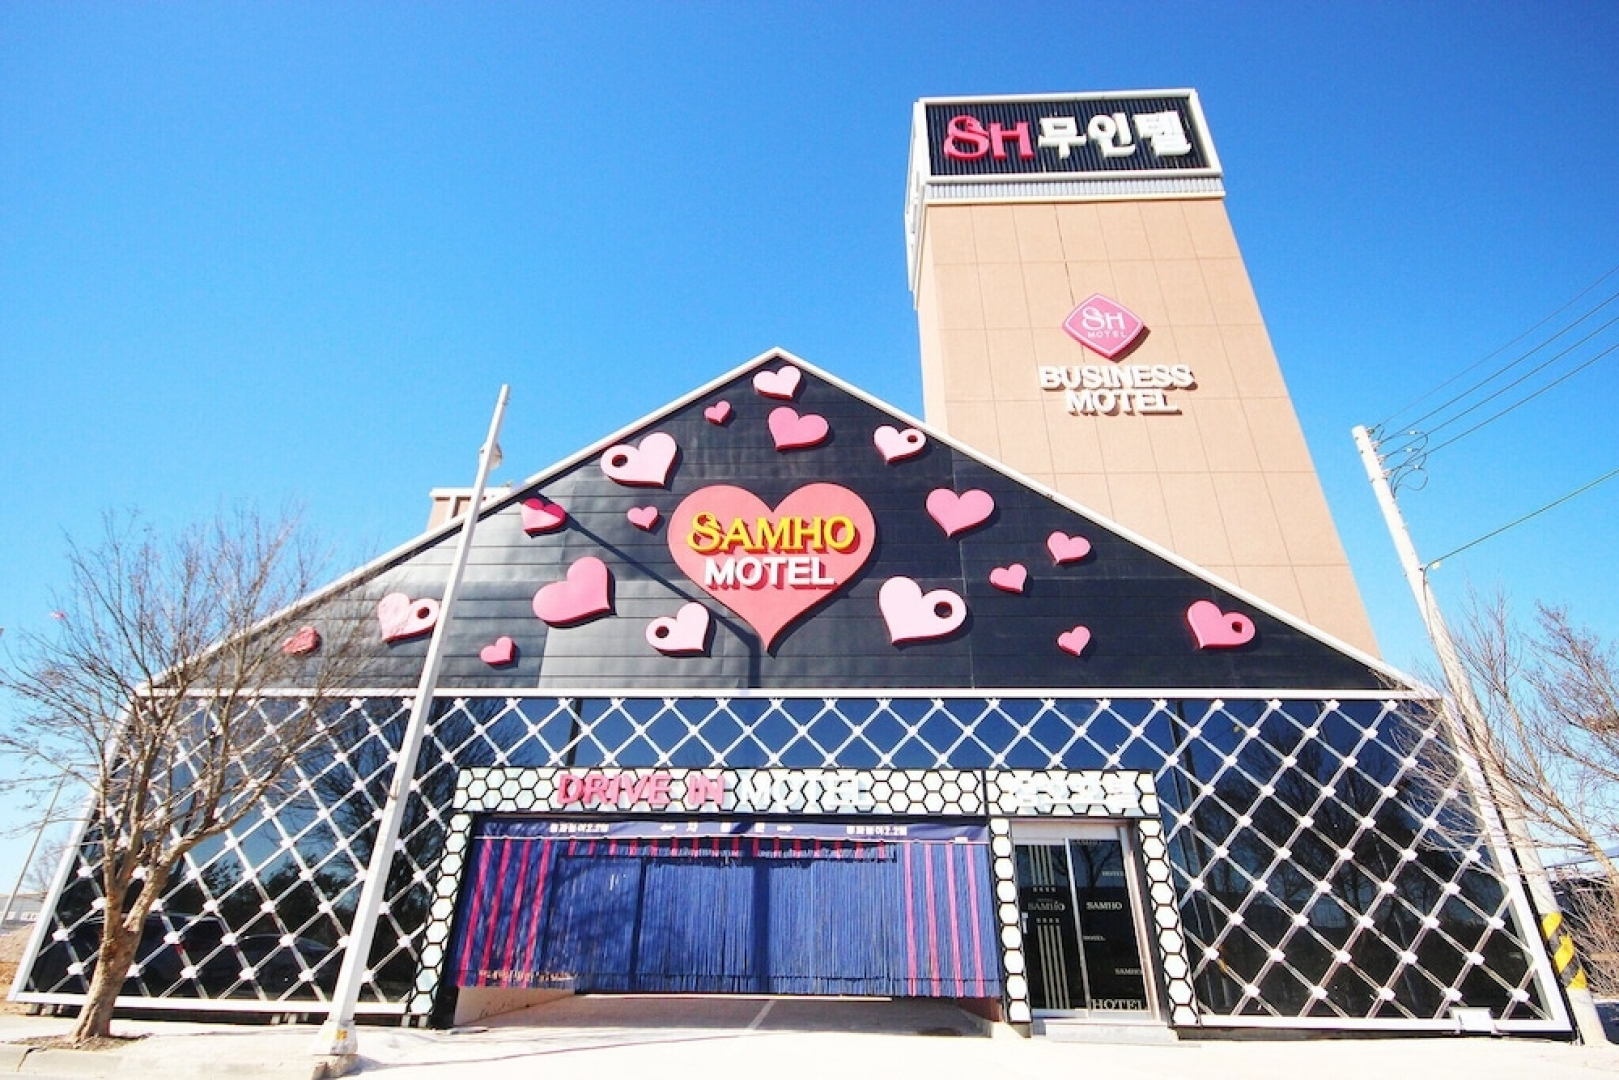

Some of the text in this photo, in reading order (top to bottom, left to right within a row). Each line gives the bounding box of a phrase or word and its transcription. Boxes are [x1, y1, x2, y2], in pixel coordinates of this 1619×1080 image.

[1081, 306, 1126, 332] SH
[1087, 330, 1128, 339] MOTEL
[1039, 364, 1196, 391] BUSINESS
[1065, 389, 1181, 416] MOTEL
[686, 511, 858, 553] SAMHO
[705, 556, 836, 588] MOTEL
[556, 773, 873, 808] DRIVE IN MOTEL
[1086, 901, 1122, 911] SAMHO
